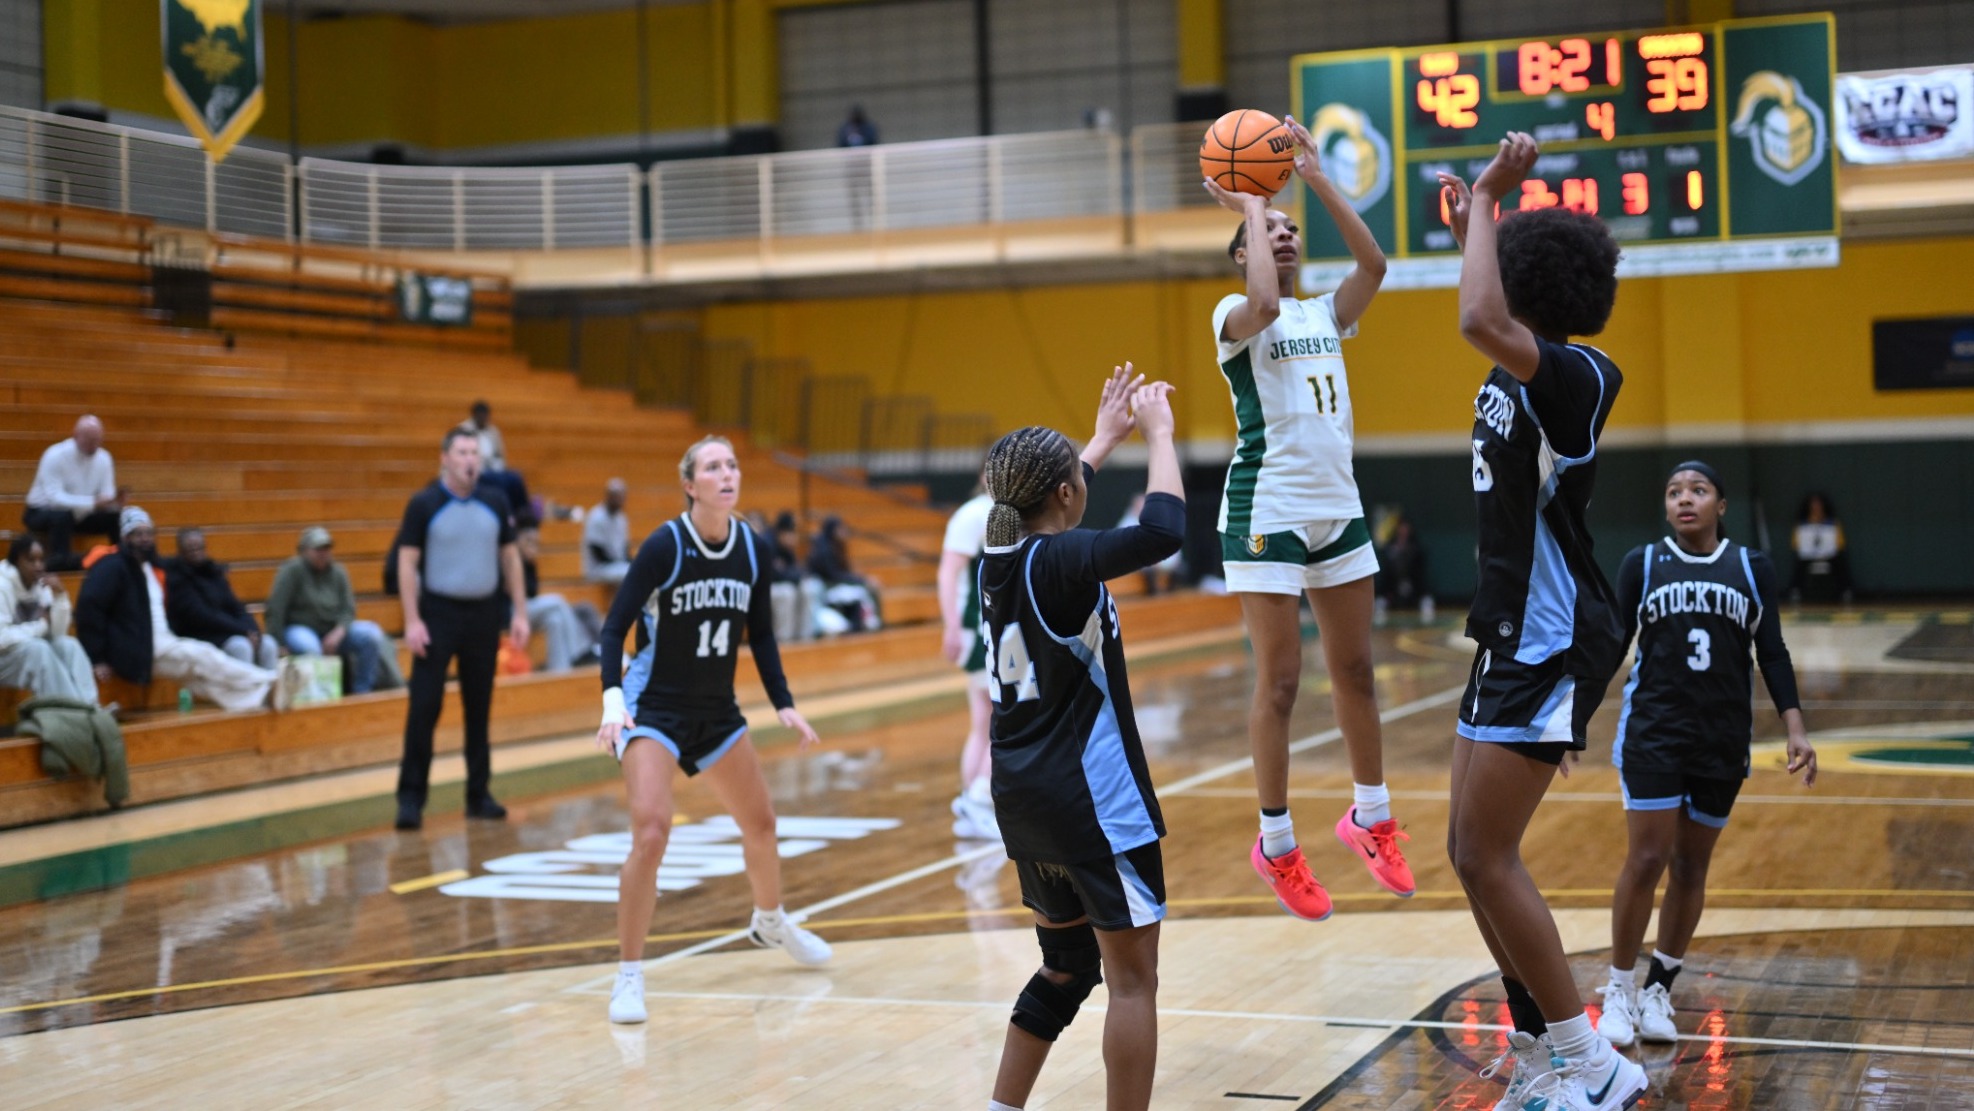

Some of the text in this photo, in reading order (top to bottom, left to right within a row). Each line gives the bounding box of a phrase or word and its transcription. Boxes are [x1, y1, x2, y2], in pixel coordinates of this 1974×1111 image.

[1519, 38, 1620, 95] 8:21
[1646, 57, 1708, 113] 39
[1417, 73, 1480, 129] 42
[1585, 102, 1615, 141] 4
[1621, 172, 1649, 215] 3
[1687, 170, 1703, 210] 1
[1270, 337, 1342, 360] JERSEY CIT
[1306, 374, 1337, 414] 11
[1646, 580, 1750, 630] STOCKTON
[696, 618, 731, 657] 14
[1686, 627, 1711, 671] 3
[983, 620, 1041, 703] 24
